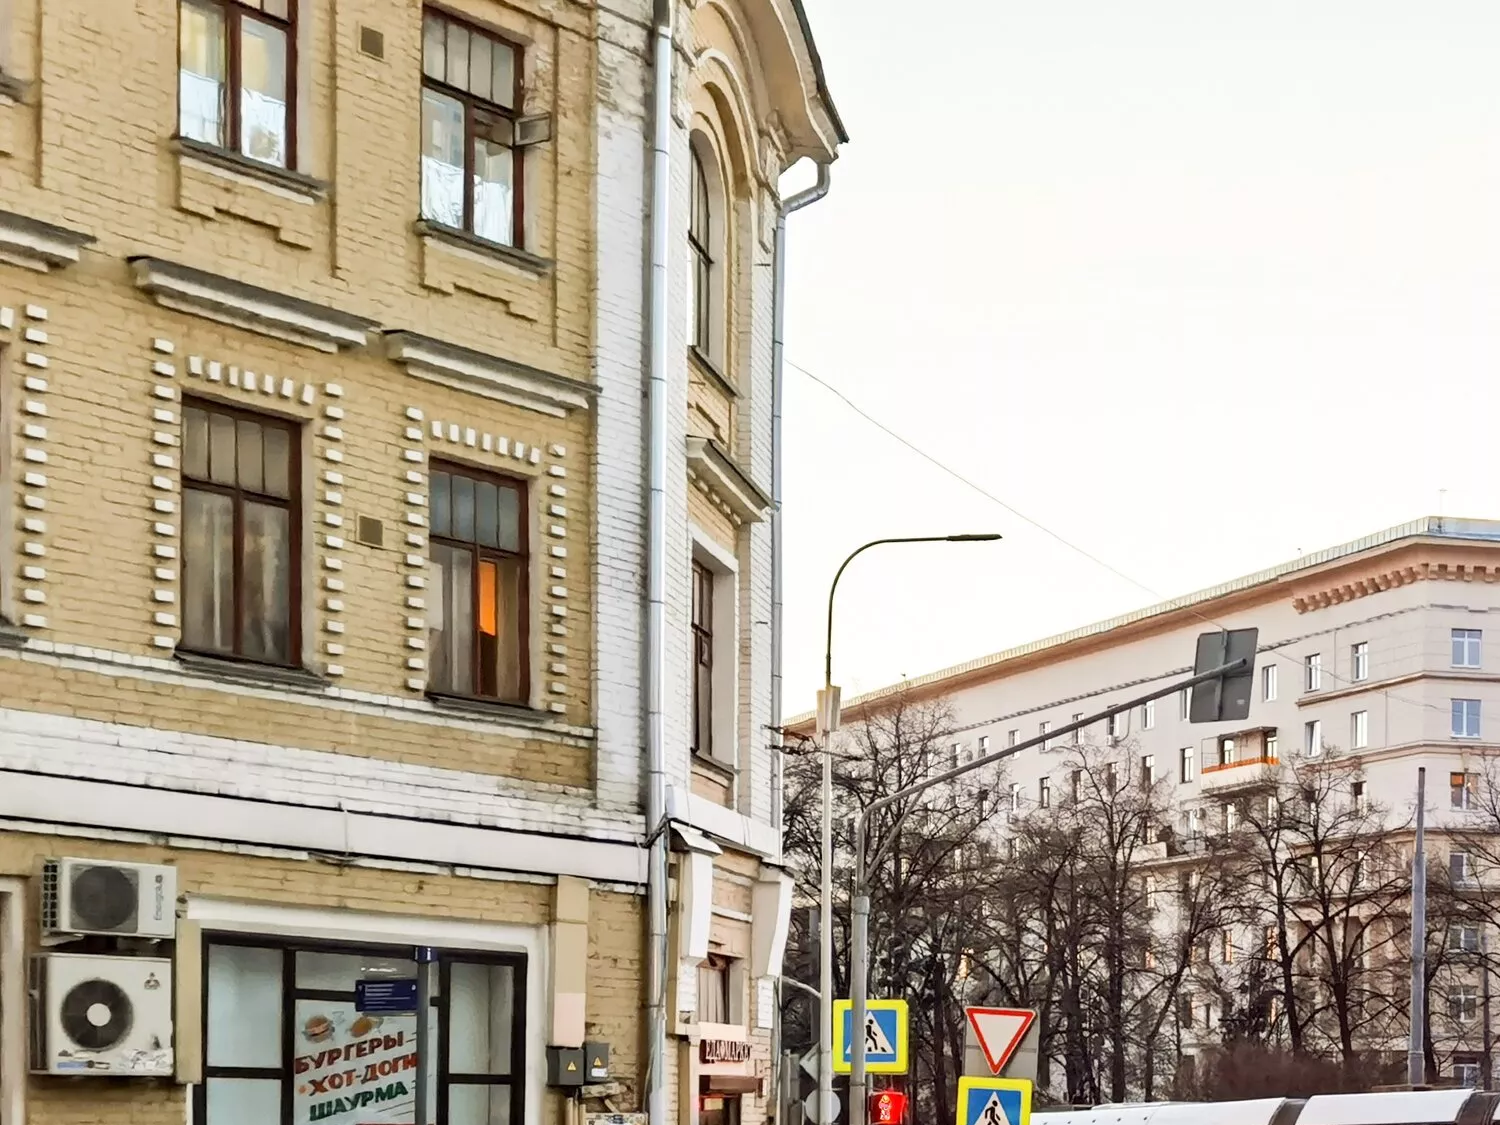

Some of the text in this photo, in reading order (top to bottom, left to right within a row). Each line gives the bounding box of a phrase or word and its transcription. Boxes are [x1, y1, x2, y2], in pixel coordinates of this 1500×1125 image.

[294, 1031, 404, 1074] БУРГЕРЫ
[308, 1052, 418, 1096] ХОТ-ДОГИ
[309, 1081, 408, 1121] ШАУРМА
